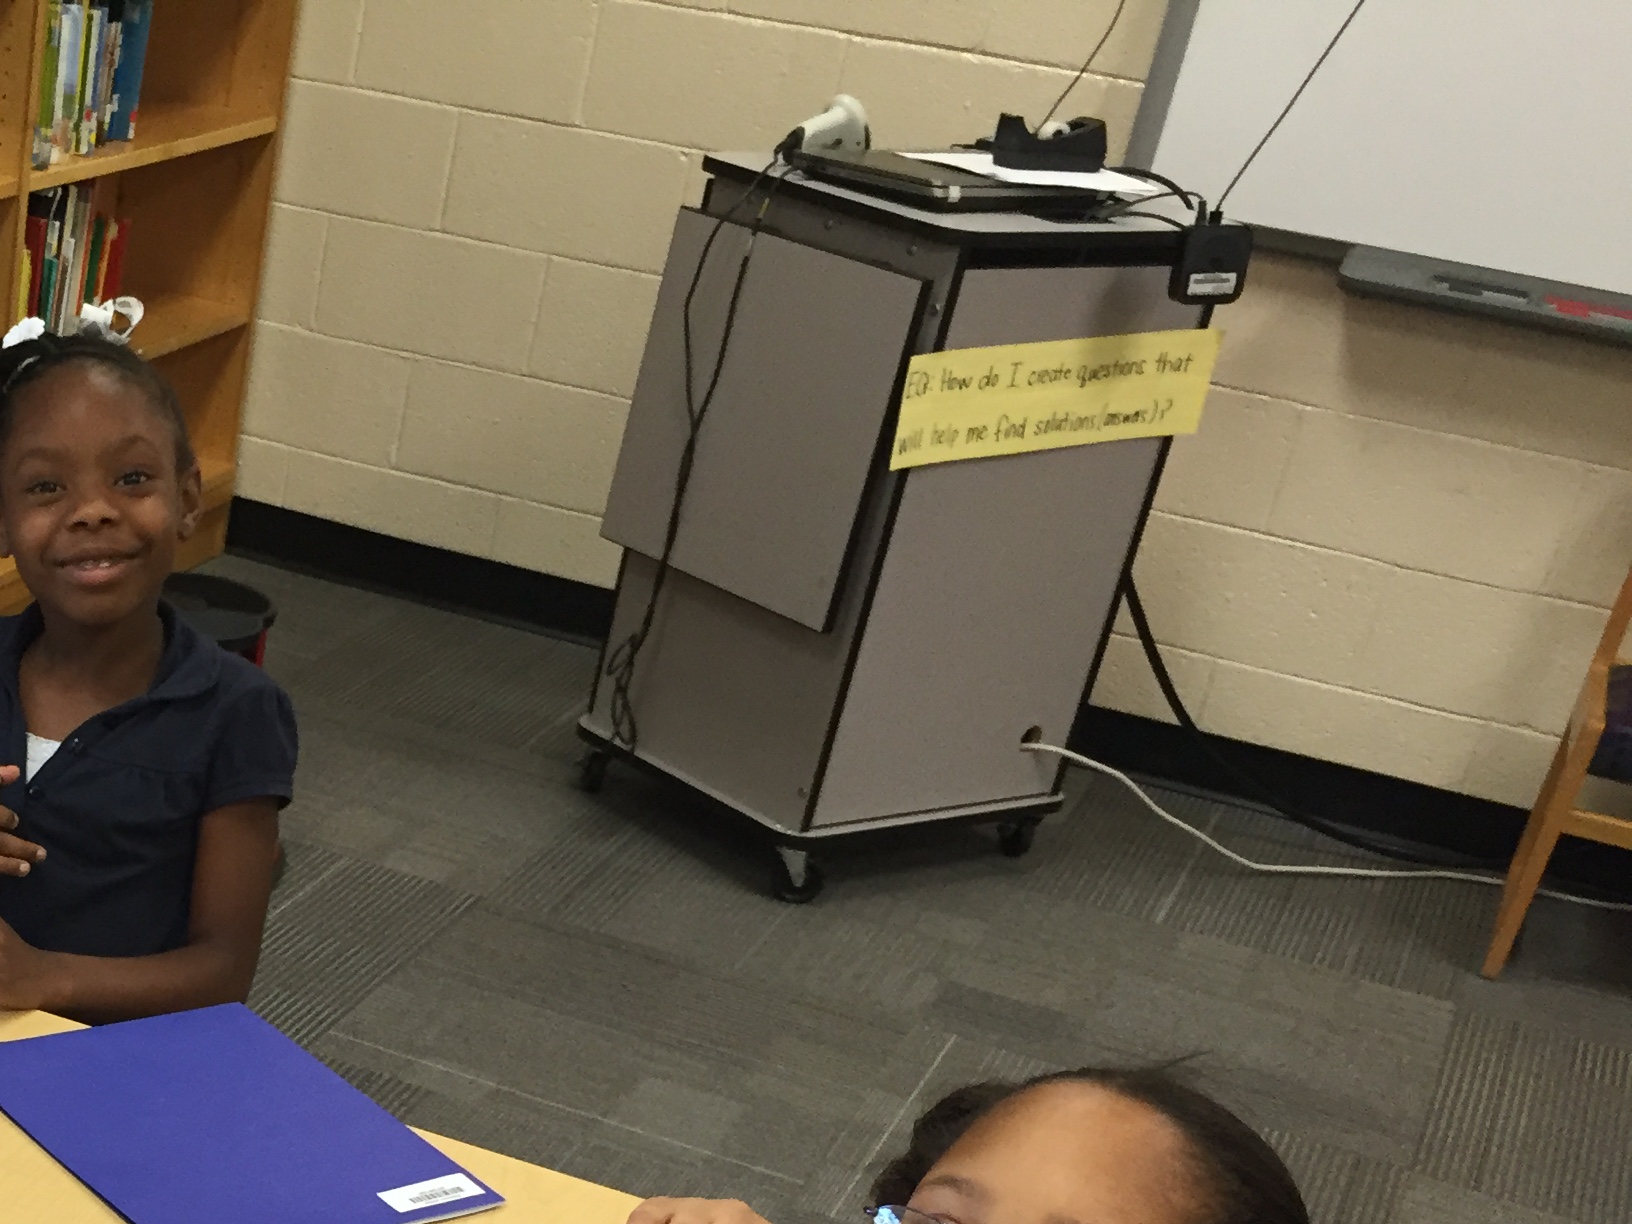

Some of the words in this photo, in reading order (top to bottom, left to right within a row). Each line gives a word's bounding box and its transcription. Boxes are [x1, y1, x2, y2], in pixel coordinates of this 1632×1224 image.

[940, 367, 974, 392] How
[977, 364, 1000, 391] do
[1006, 360, 1024, 388] I
[1027, 362, 1072, 387] create
[1076, 359, 1147, 388] questions
[1155, 351, 1195, 374] that
[898, 427, 924, 456] will
[930, 422, 960, 448] help
[965, 425, 989, 445] me
[994, 413, 1028, 442] find
